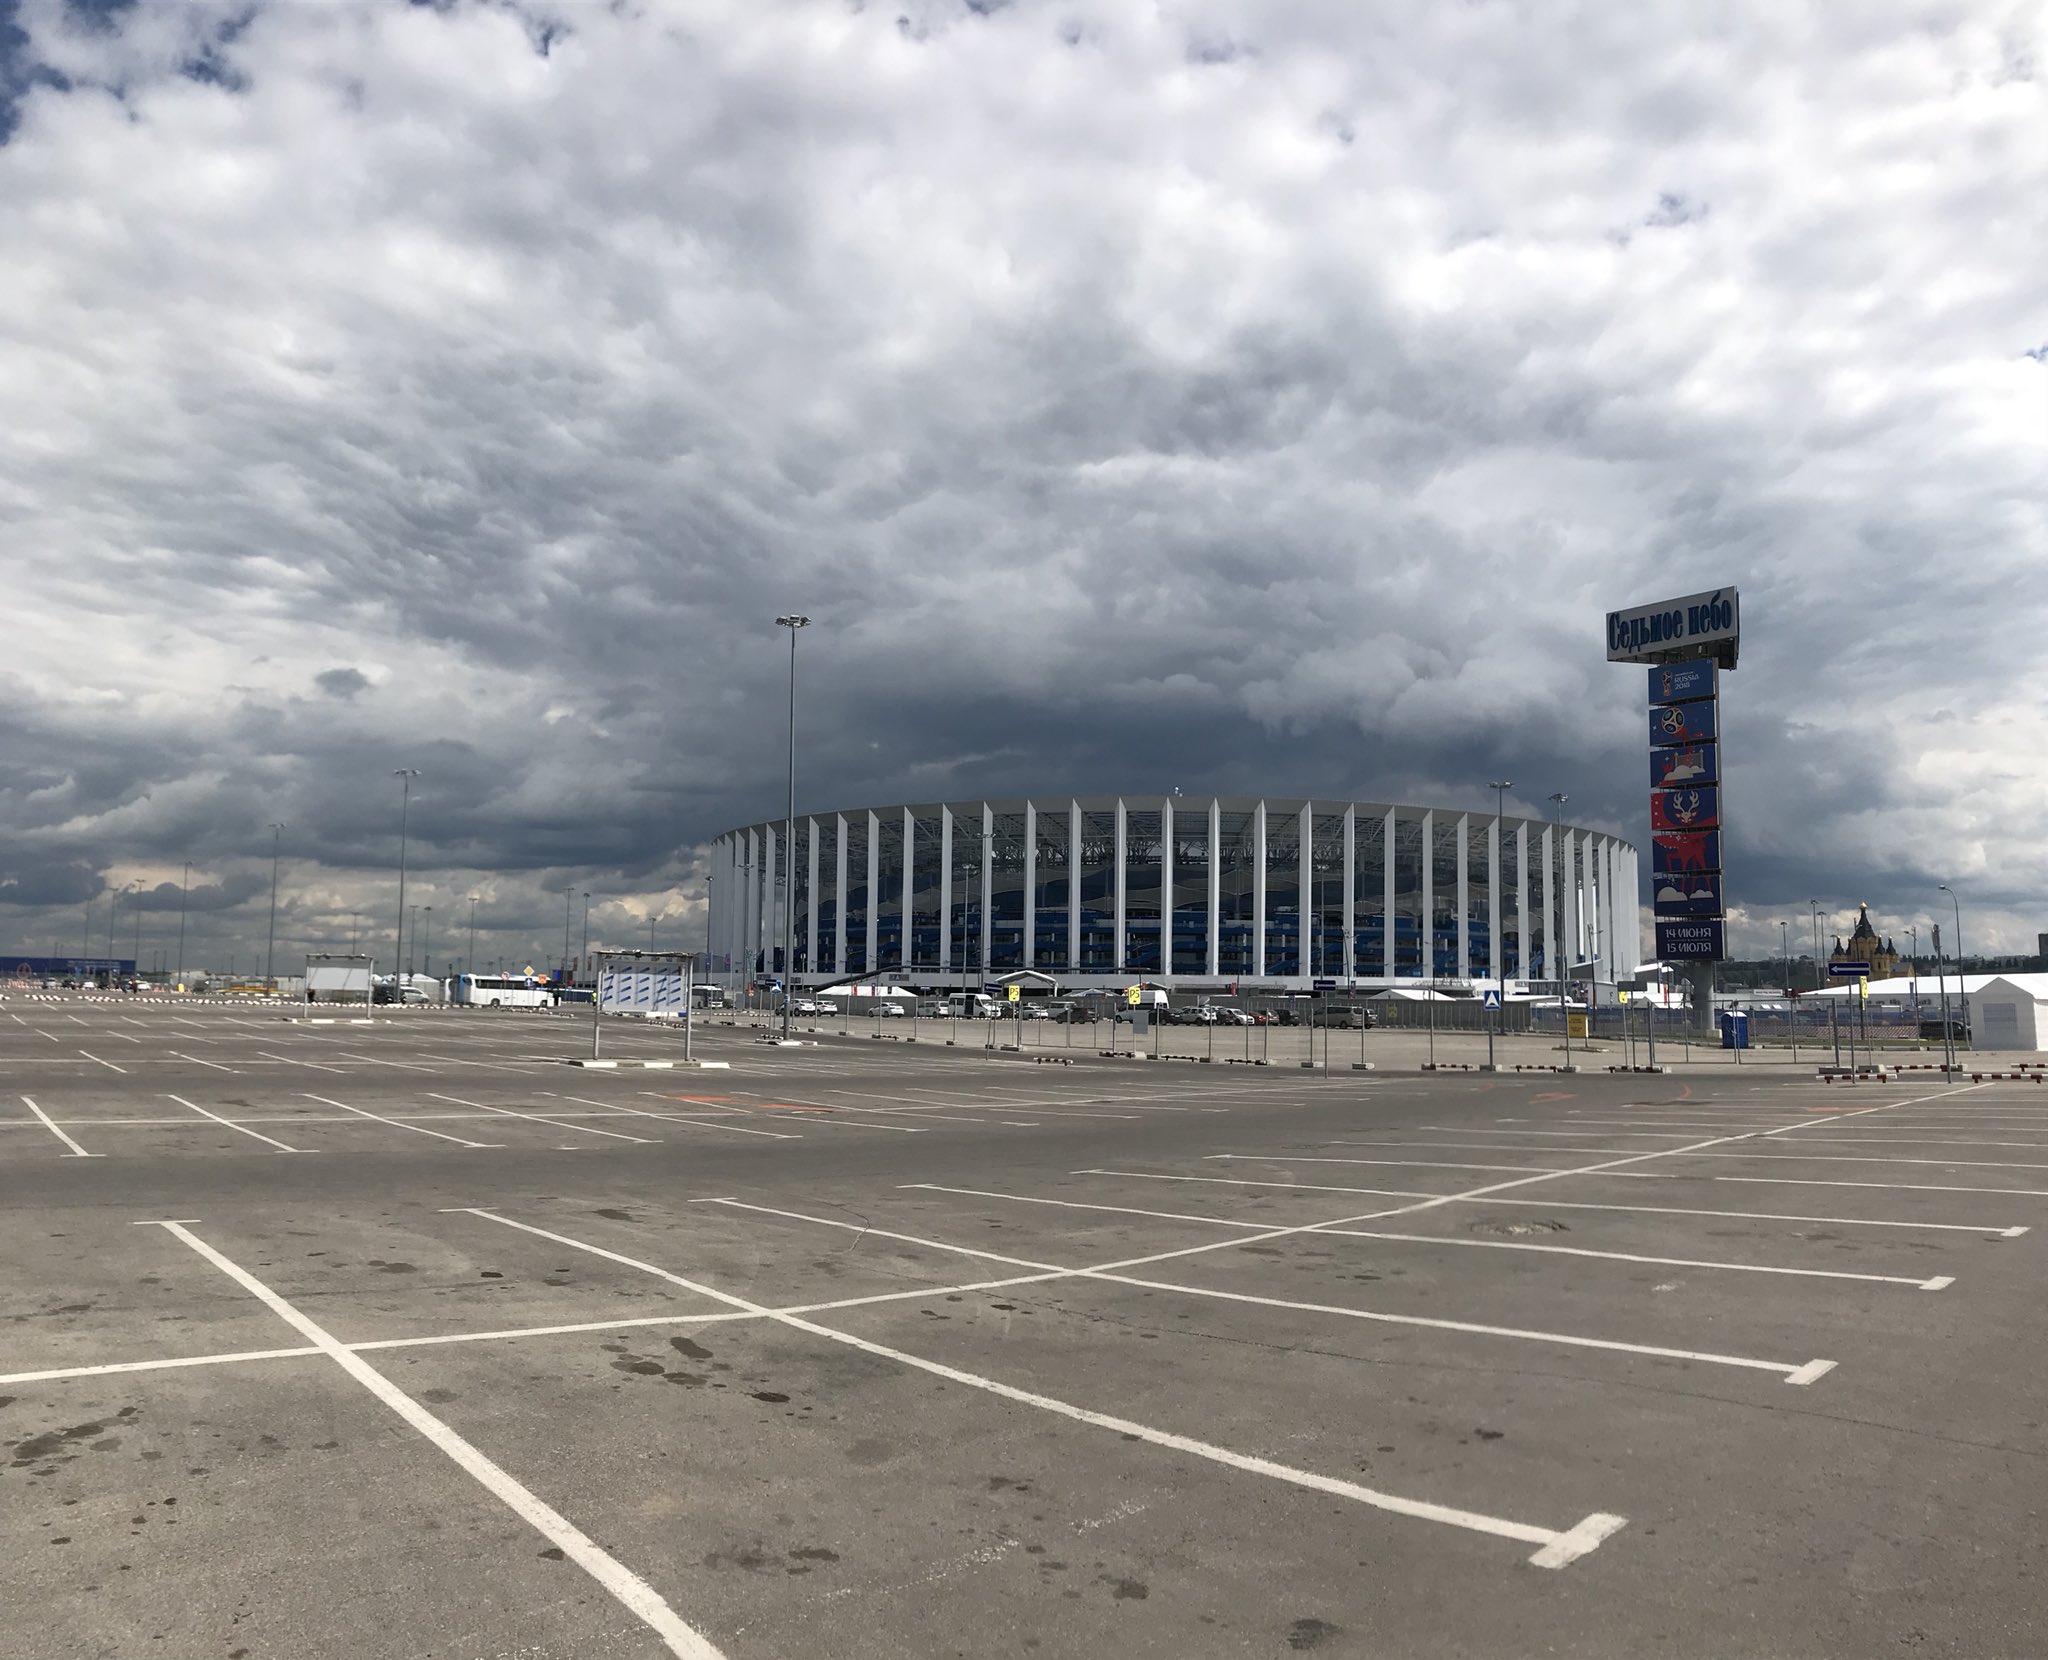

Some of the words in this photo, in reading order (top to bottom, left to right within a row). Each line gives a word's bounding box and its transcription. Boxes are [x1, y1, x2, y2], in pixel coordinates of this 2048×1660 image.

[1609, 613, 1683, 653] Седьмое
[1688, 590, 1732, 636] небо
[1674, 674, 1700, 683] RUSSIA
[1674, 682, 1690, 690] 2018
[1665, 928, 1676, 938] 14
[1677, 927, 1712, 938] ИЮНЯ
[1666, 943, 1677, 953] 15
[1678, 942, 1712, 953] ИЮЛЯ
